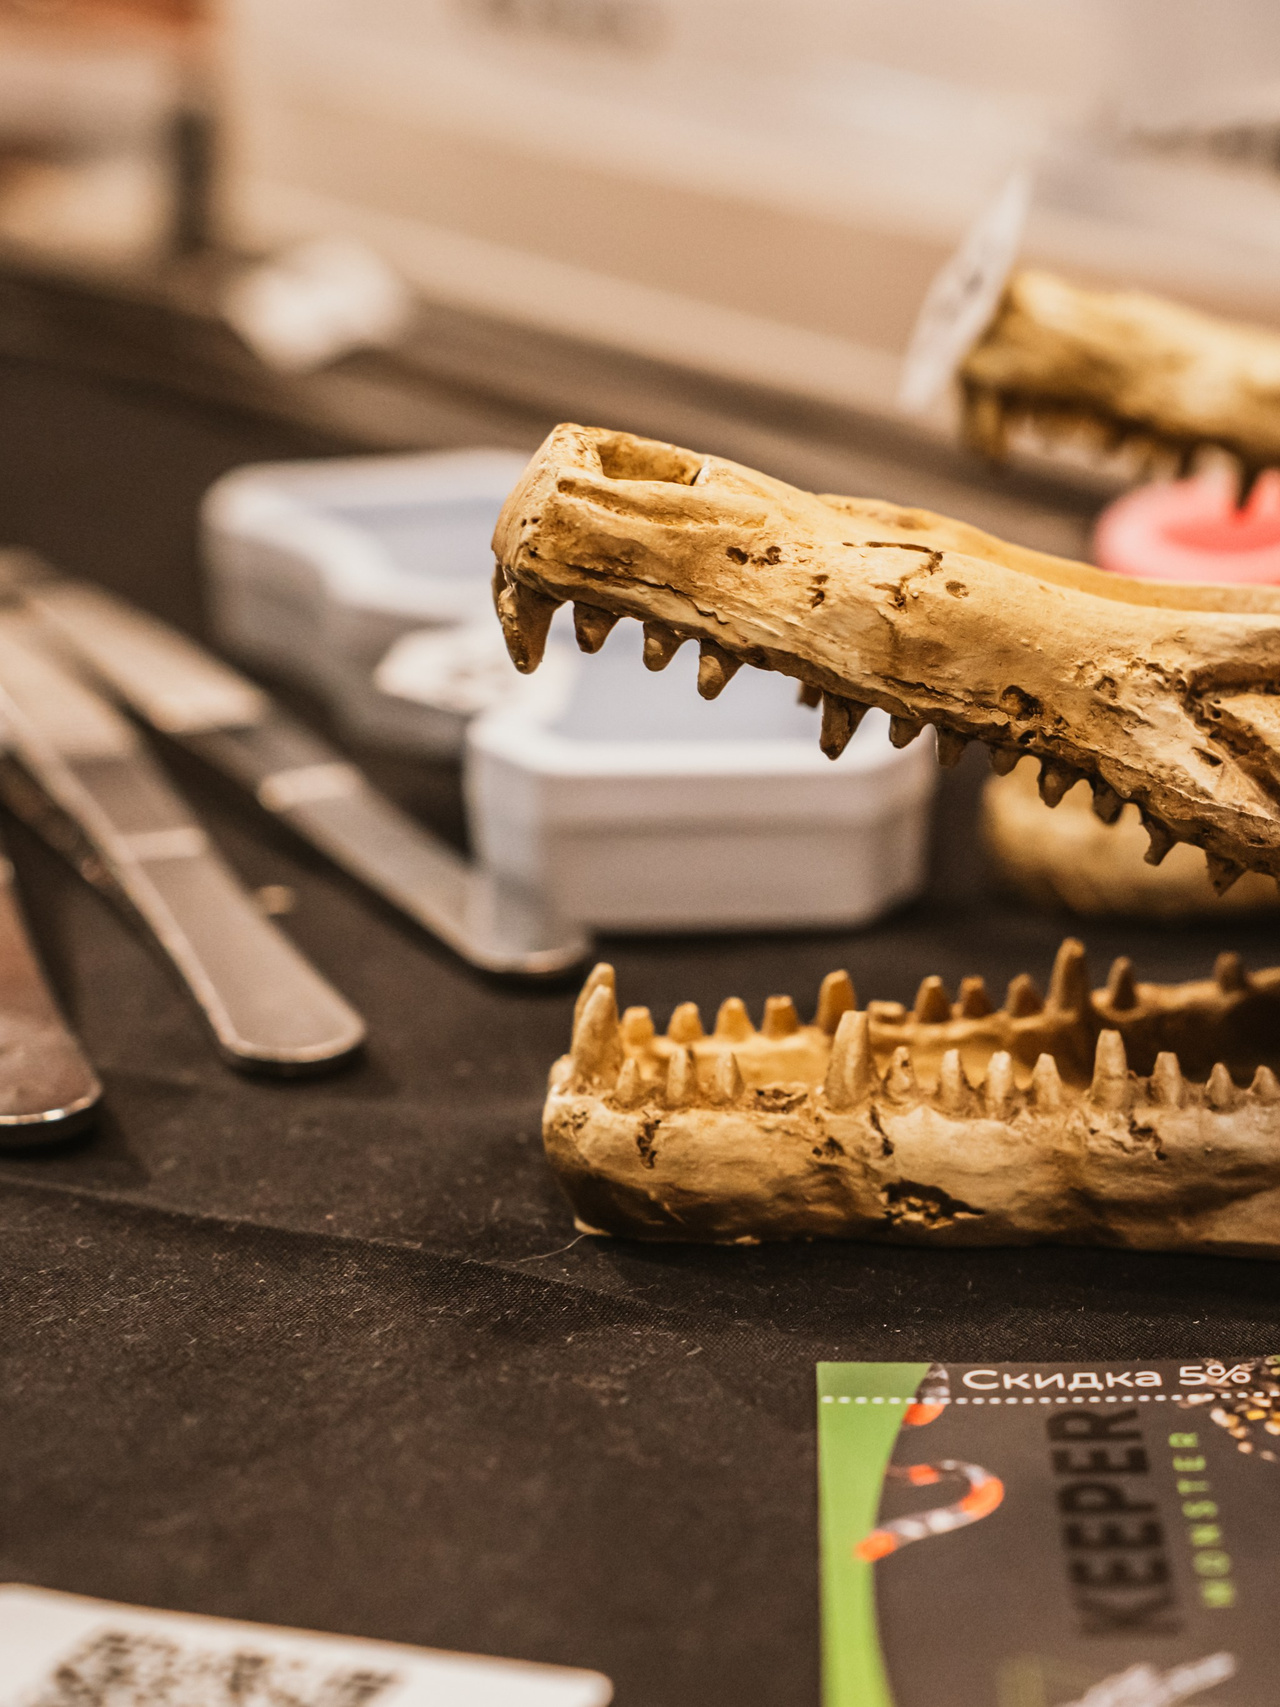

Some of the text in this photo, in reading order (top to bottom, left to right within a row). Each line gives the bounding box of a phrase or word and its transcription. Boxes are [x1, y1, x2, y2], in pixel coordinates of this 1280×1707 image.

[962, 1364, 1252, 1392] Скидка 5%
[1047, 1408, 1184, 1638] KEEPER
[1168, 1432, 1236, 1608] MONSTER
